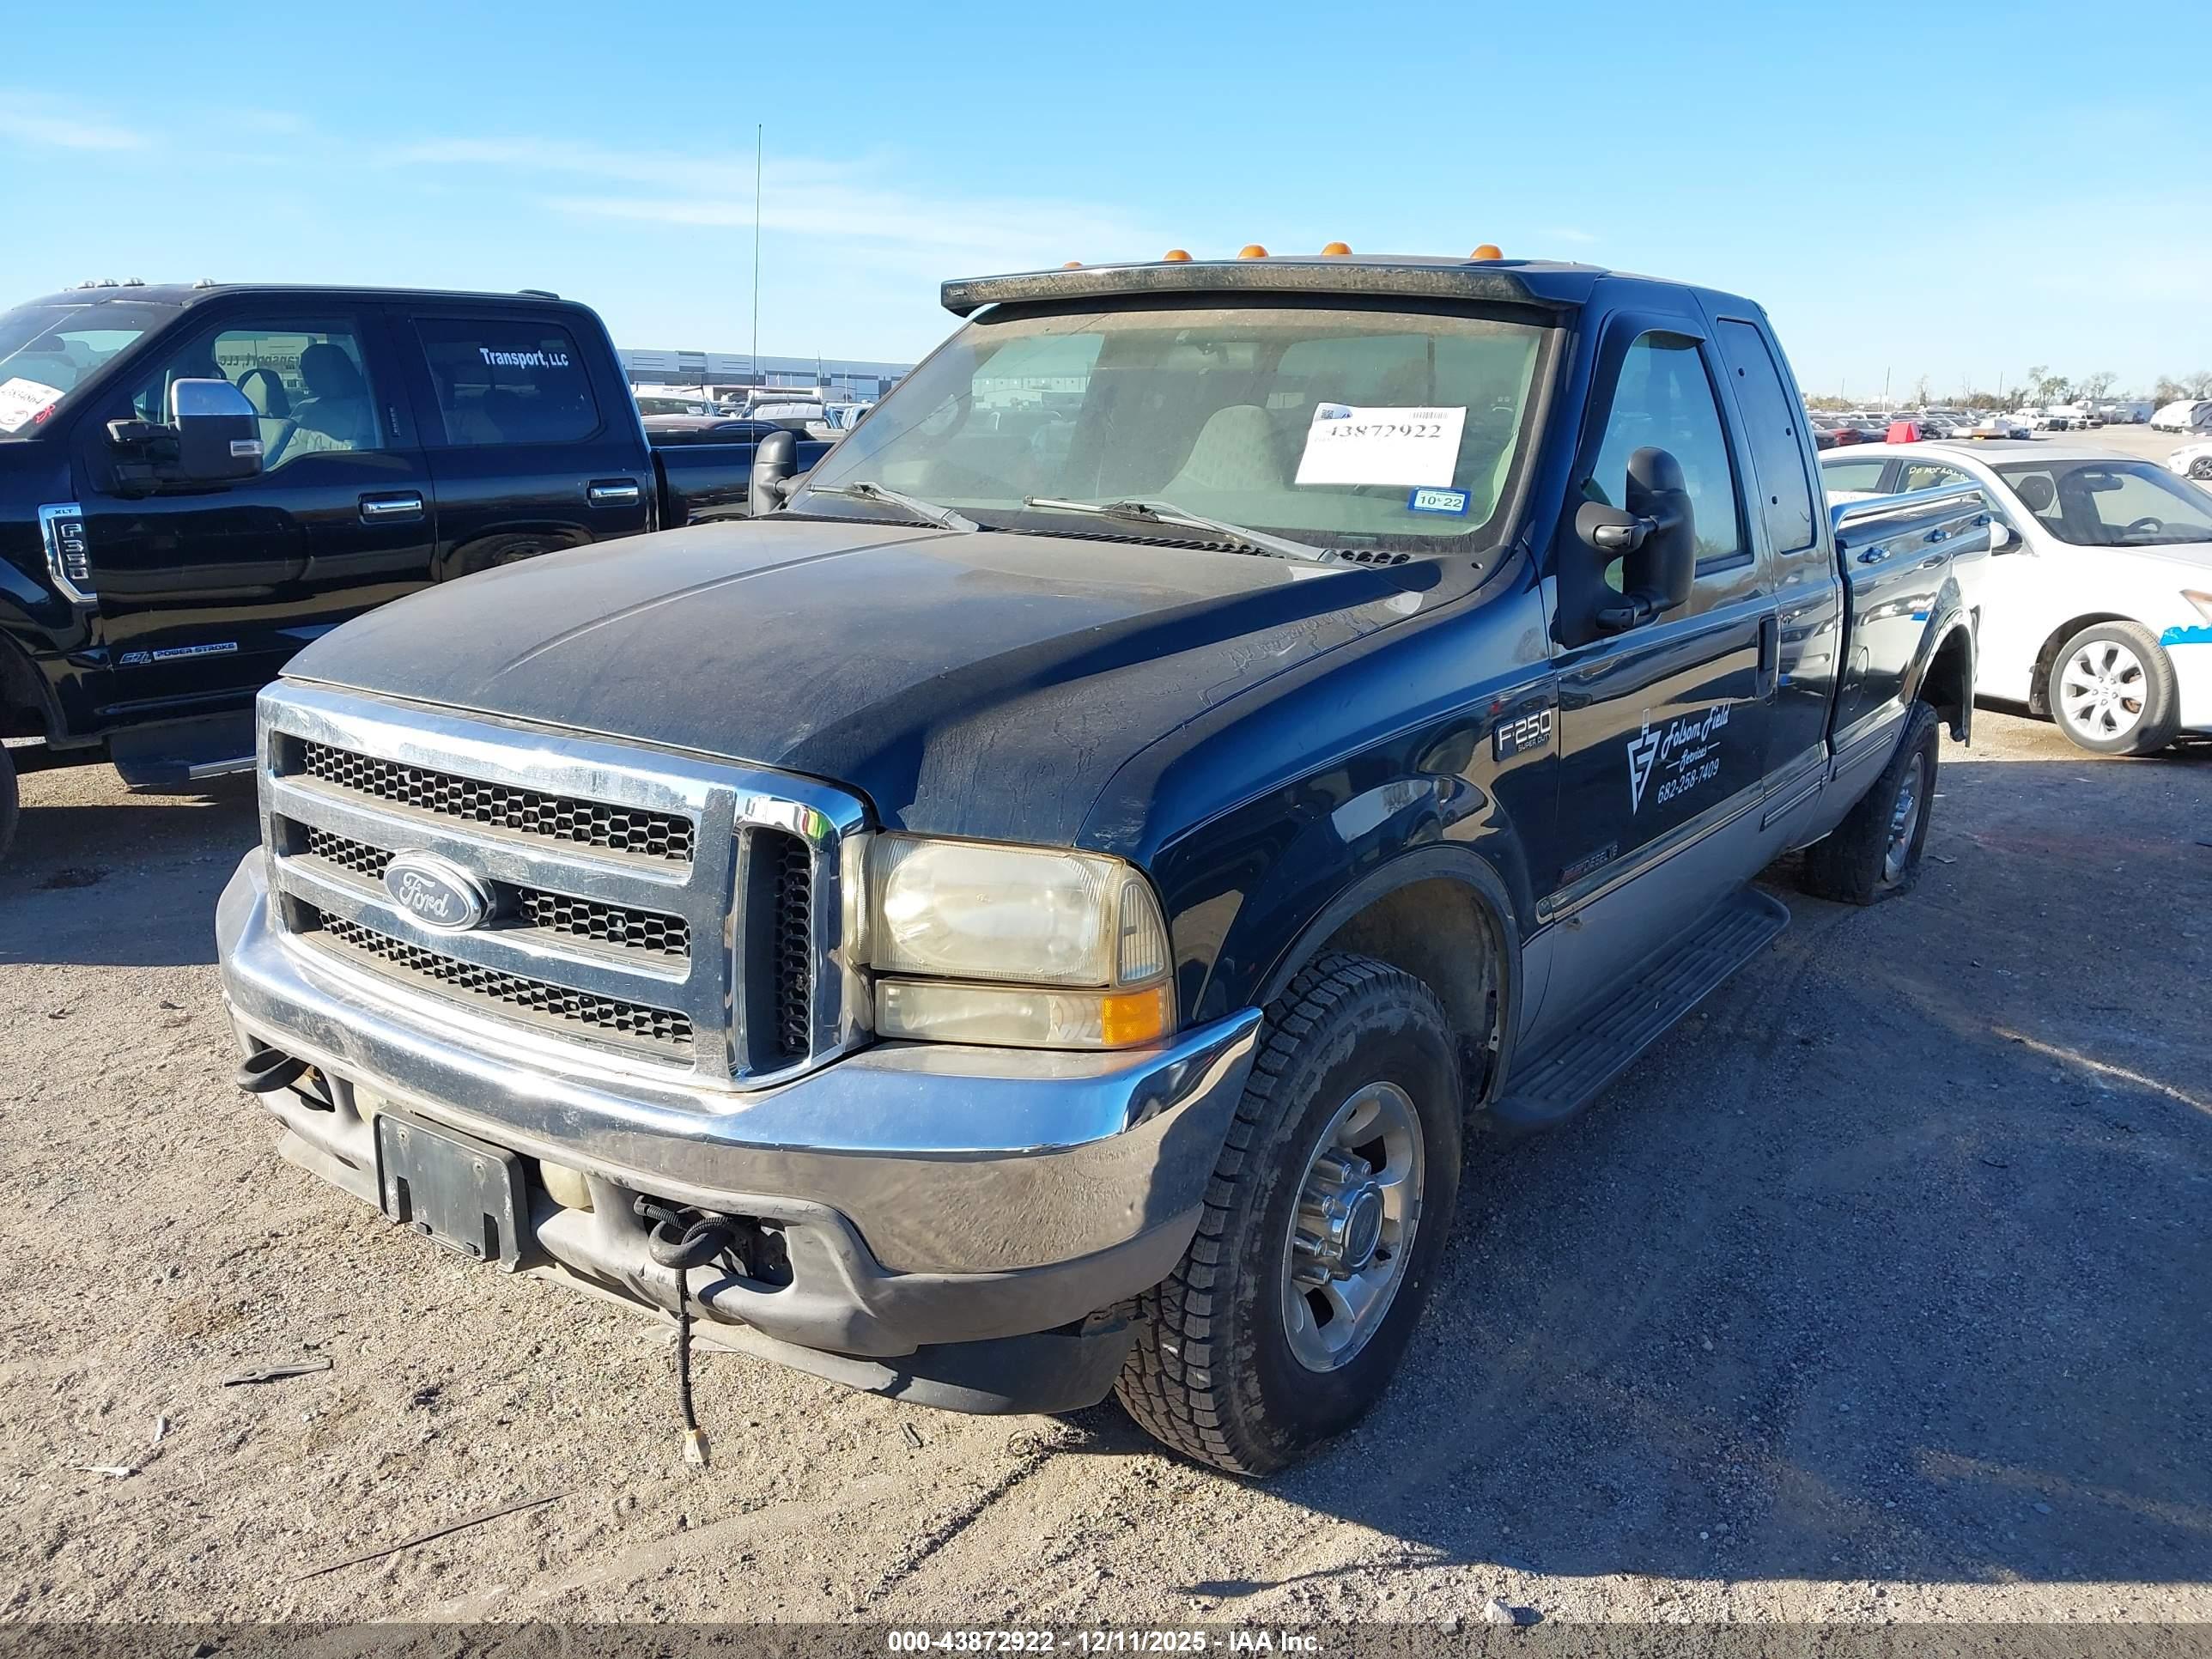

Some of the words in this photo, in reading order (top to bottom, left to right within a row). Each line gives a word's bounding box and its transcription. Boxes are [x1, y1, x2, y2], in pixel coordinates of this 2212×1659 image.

[549, 354, 568, 366] LLC
[1420, 495, 1437, 506] 10
[1443, 497, 1462, 508] 22
[156, 647, 193, 658] POWER
[195, 642, 235, 653] STROKE
[1701, 701, 1731, 742] Field
[1517, 738, 1536, 752] SUPER
[1657, 757, 1720, 804] 682-258-7409
[398, 872, 450, 918] Ford
